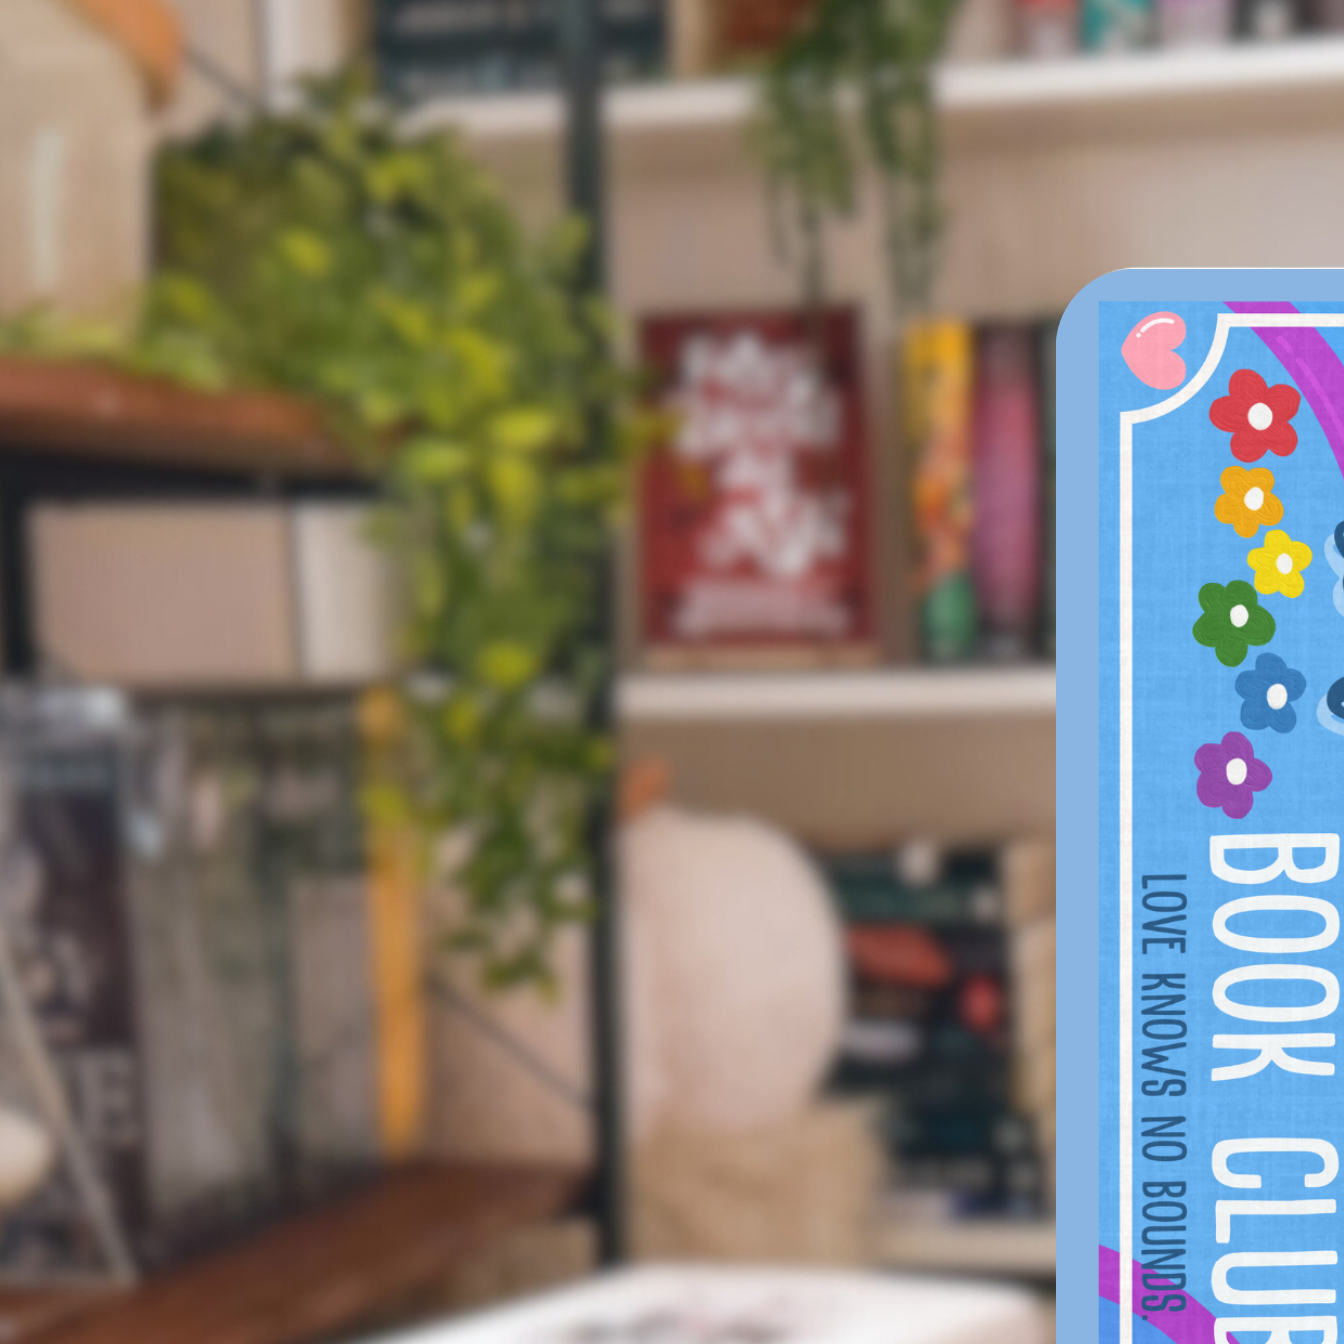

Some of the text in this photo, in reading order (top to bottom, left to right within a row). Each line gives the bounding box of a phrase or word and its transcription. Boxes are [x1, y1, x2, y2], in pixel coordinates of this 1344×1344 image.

[1140, 873, 1188, 1321] LOVE KNOWS NO BOUNDS.
[1208, 832, 1340, 1082] BOOK
